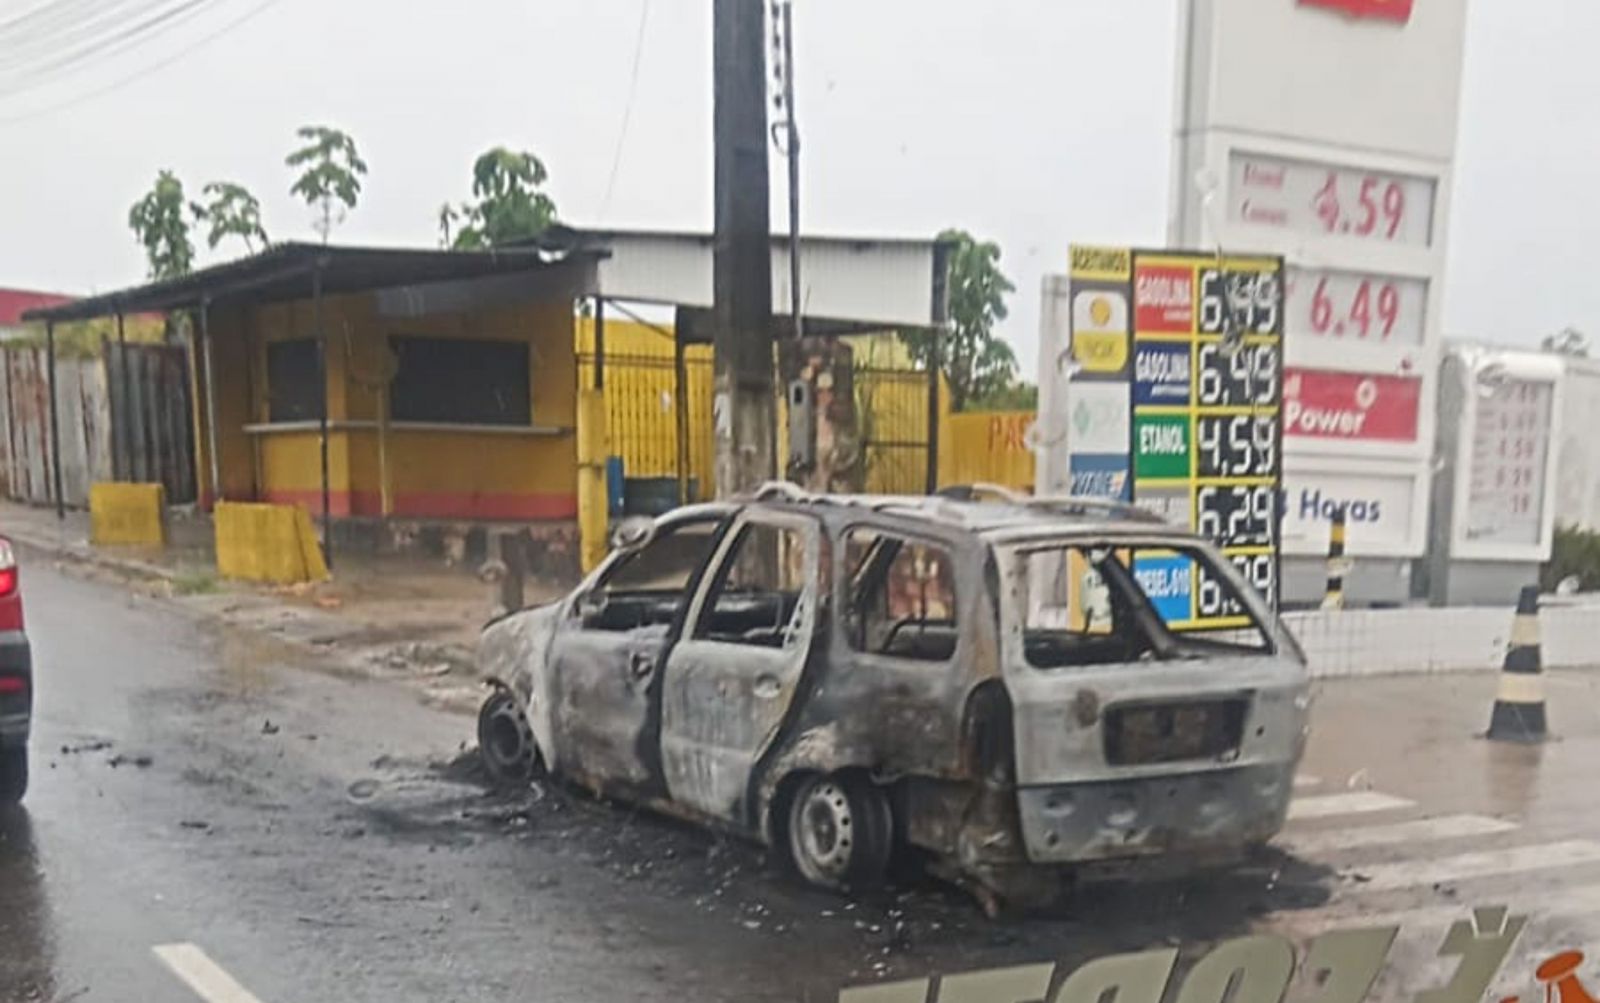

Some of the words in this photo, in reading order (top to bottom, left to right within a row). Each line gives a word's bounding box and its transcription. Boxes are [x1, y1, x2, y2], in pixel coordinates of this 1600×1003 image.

[1310, 275, 1399, 340] 6.49
[1135, 351, 1189, 382] GASOLINA
[1200, 343, 1277, 405] 6,49
[1139, 424, 1187, 455] ETANOL
[1199, 416, 1274, 477] 4,59
